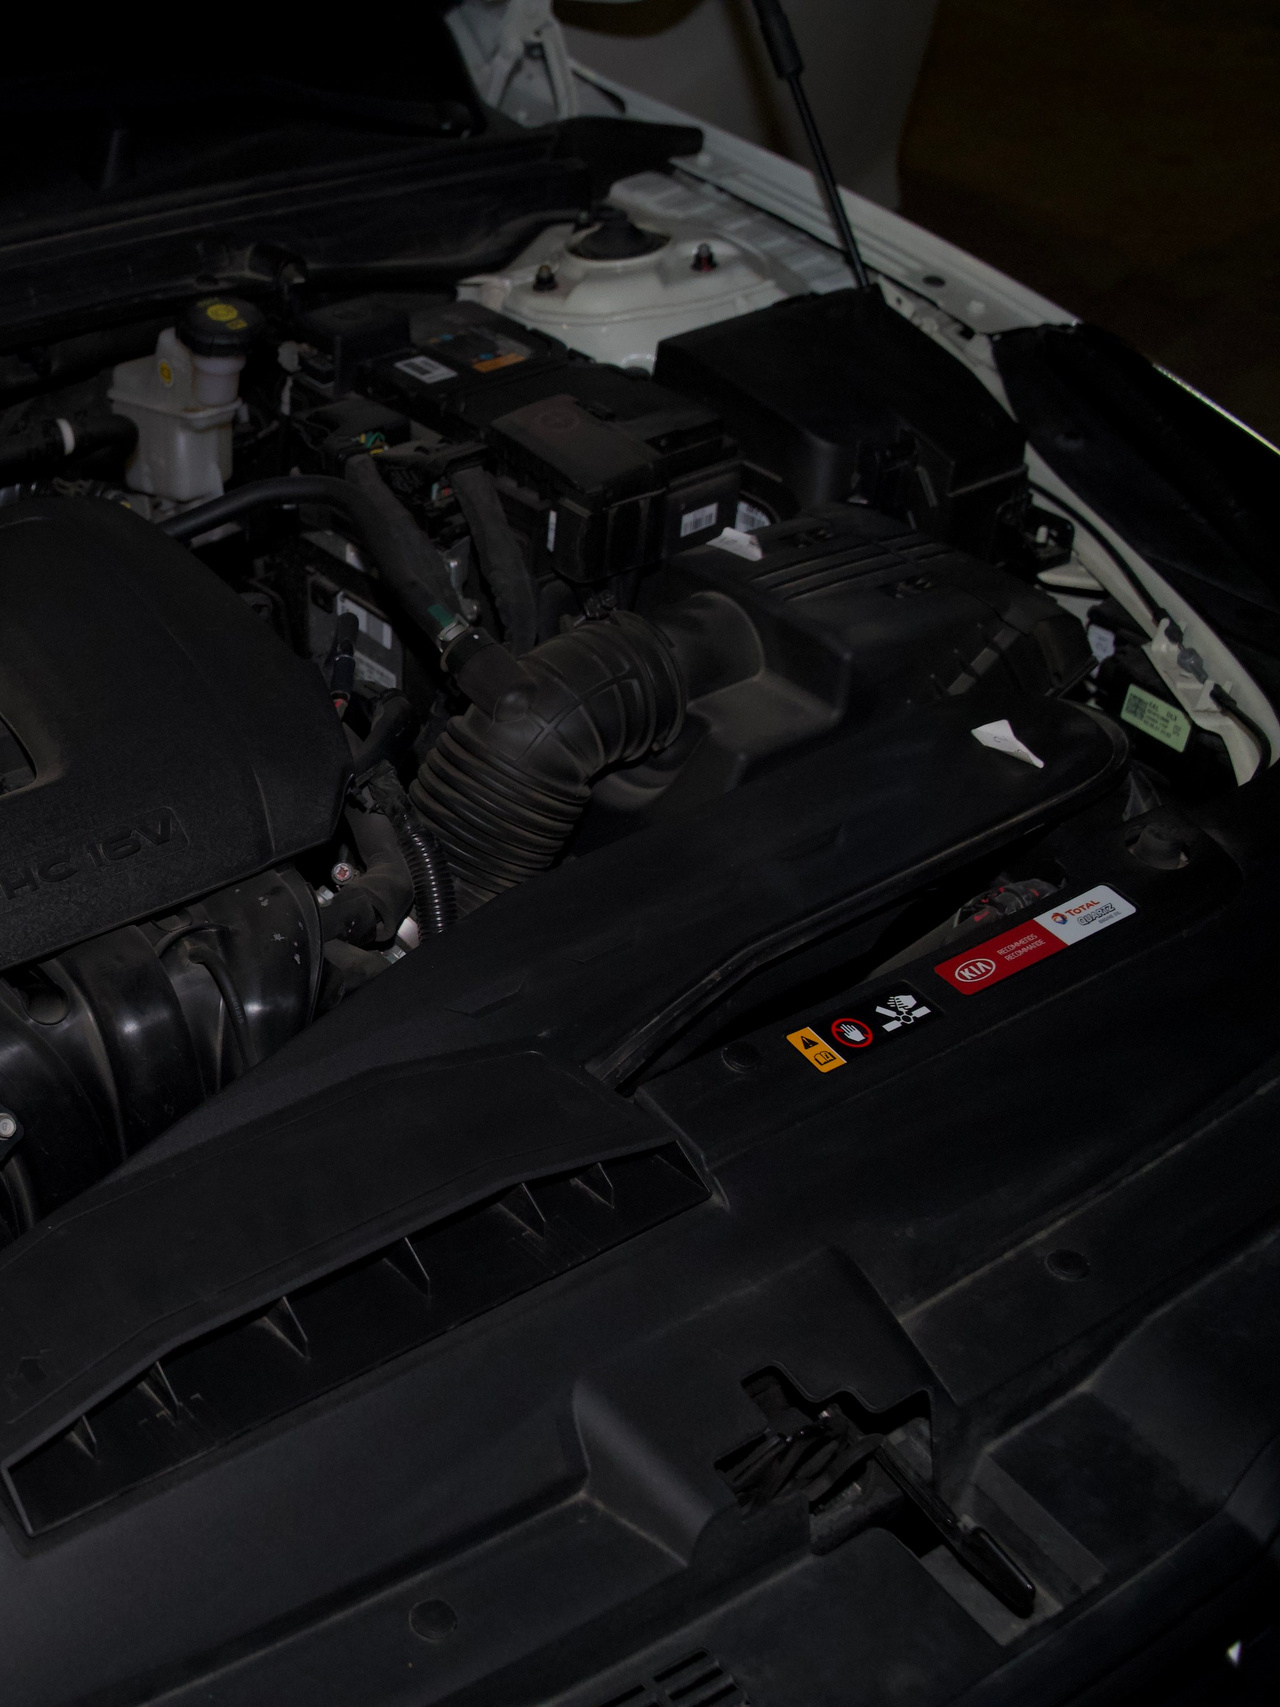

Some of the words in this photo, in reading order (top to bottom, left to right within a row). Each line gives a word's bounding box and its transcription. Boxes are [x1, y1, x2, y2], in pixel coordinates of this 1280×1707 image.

[85, 816, 173, 867] 16V
[1065, 900, 1100, 916] TOTAL
[1077, 902, 1116, 926] QUARTZ
[997, 933, 1037, 955] RECOMMENDS
[959, 961, 992, 980] KIA
